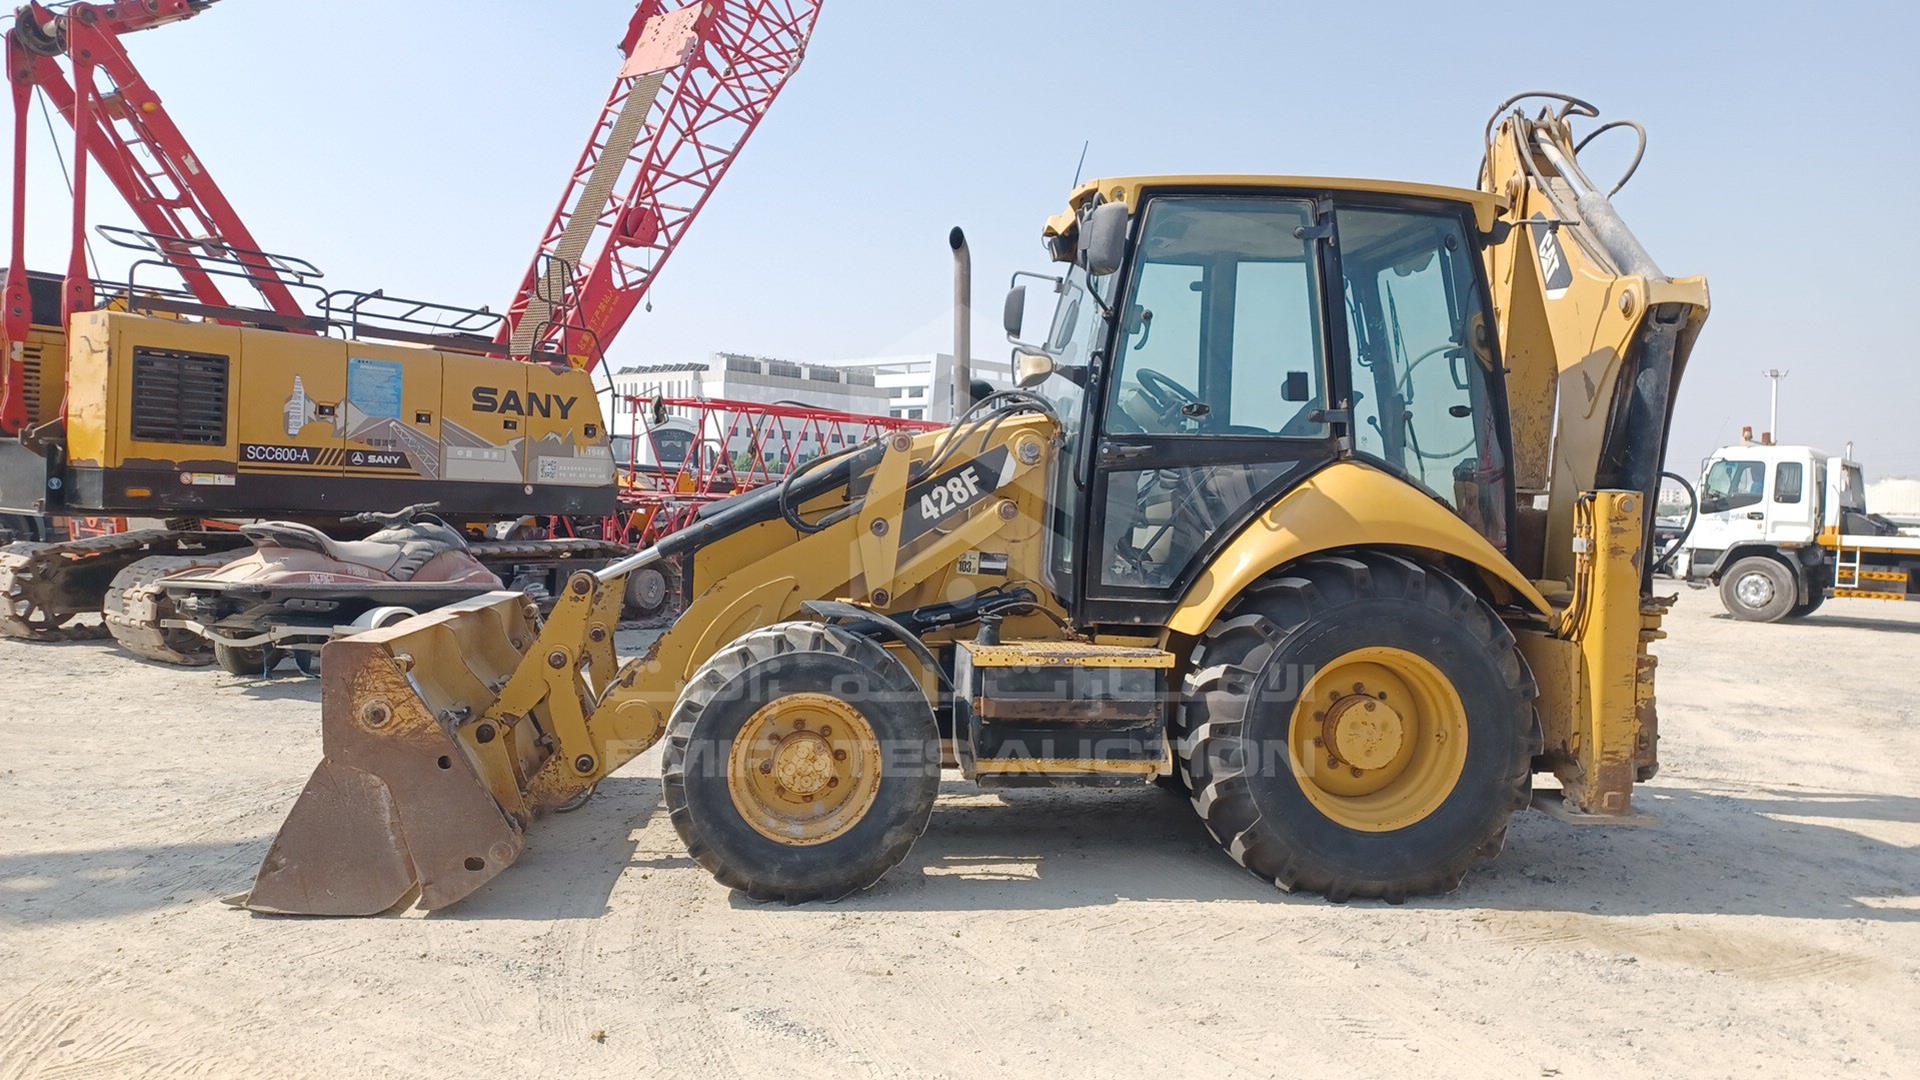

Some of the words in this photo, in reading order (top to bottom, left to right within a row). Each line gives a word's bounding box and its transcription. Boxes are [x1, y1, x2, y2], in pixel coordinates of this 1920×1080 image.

[1538, 230, 1560, 284] CAT
[472, 387, 577, 419] SANY
[246, 445, 310, 462] SCC600-A
[367, 454, 401, 465] SANY
[920, 466, 980, 519] 428F
[958, 560, 972, 573] 103
